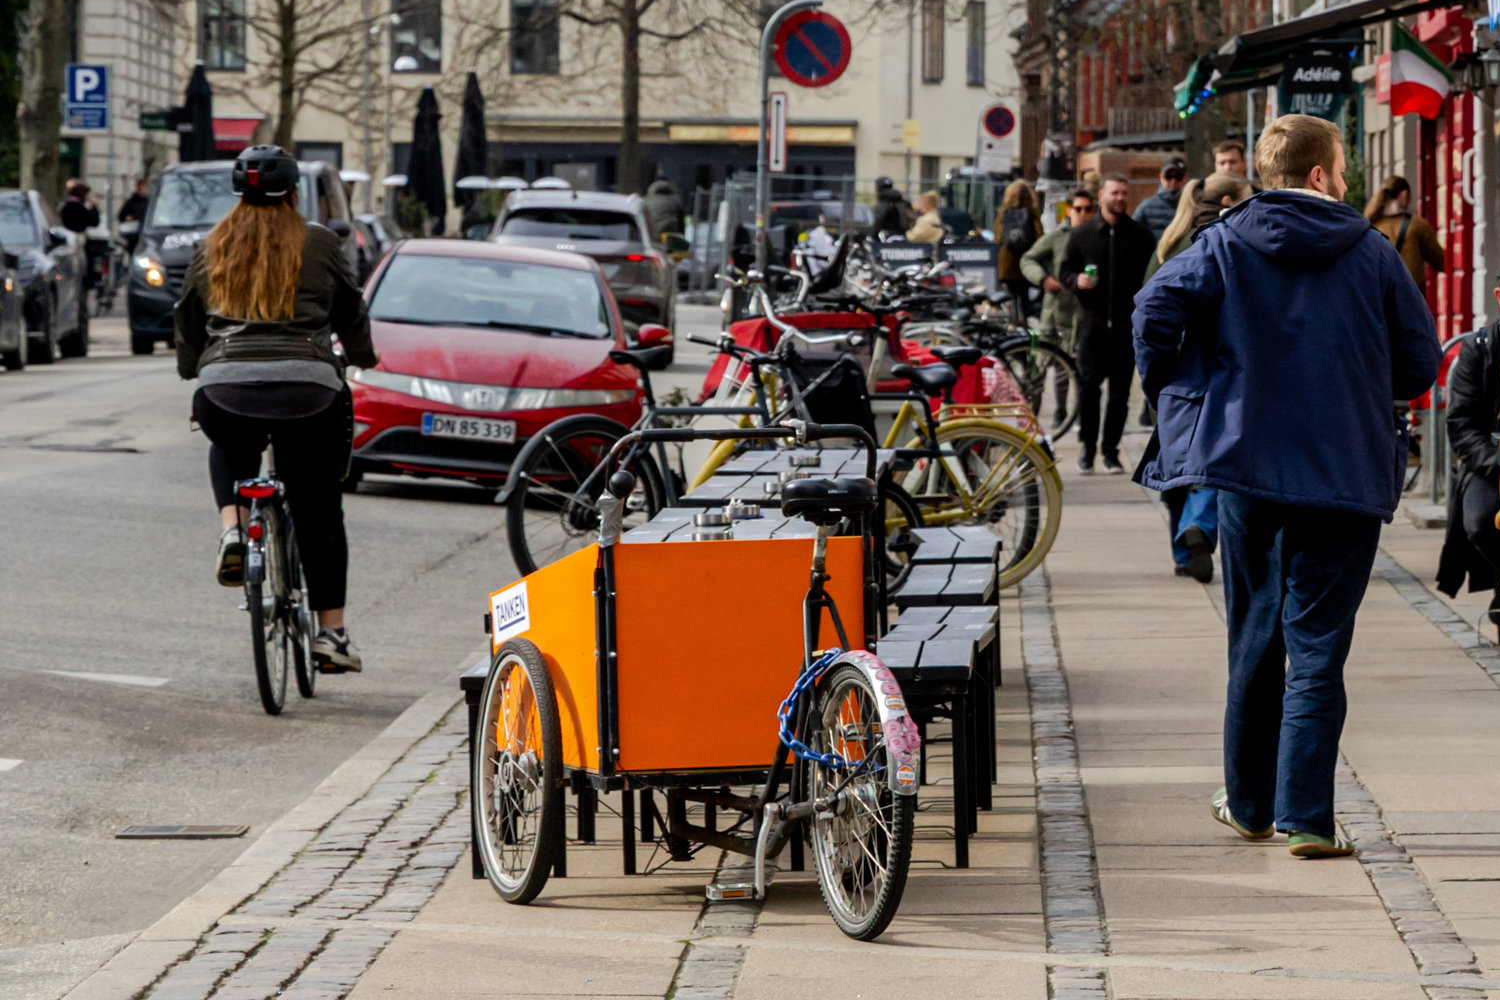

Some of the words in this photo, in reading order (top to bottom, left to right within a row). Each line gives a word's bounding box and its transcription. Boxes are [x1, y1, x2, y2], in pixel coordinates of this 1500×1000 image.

[75, 68, 100, 101] P
[1293, 66, 1341, 82] Adélie
[433, 418, 456, 433] DN
[460, 420, 479, 435] 85
[482, 423, 512, 439] 339
[496, 593, 525, 631] TANKEN
